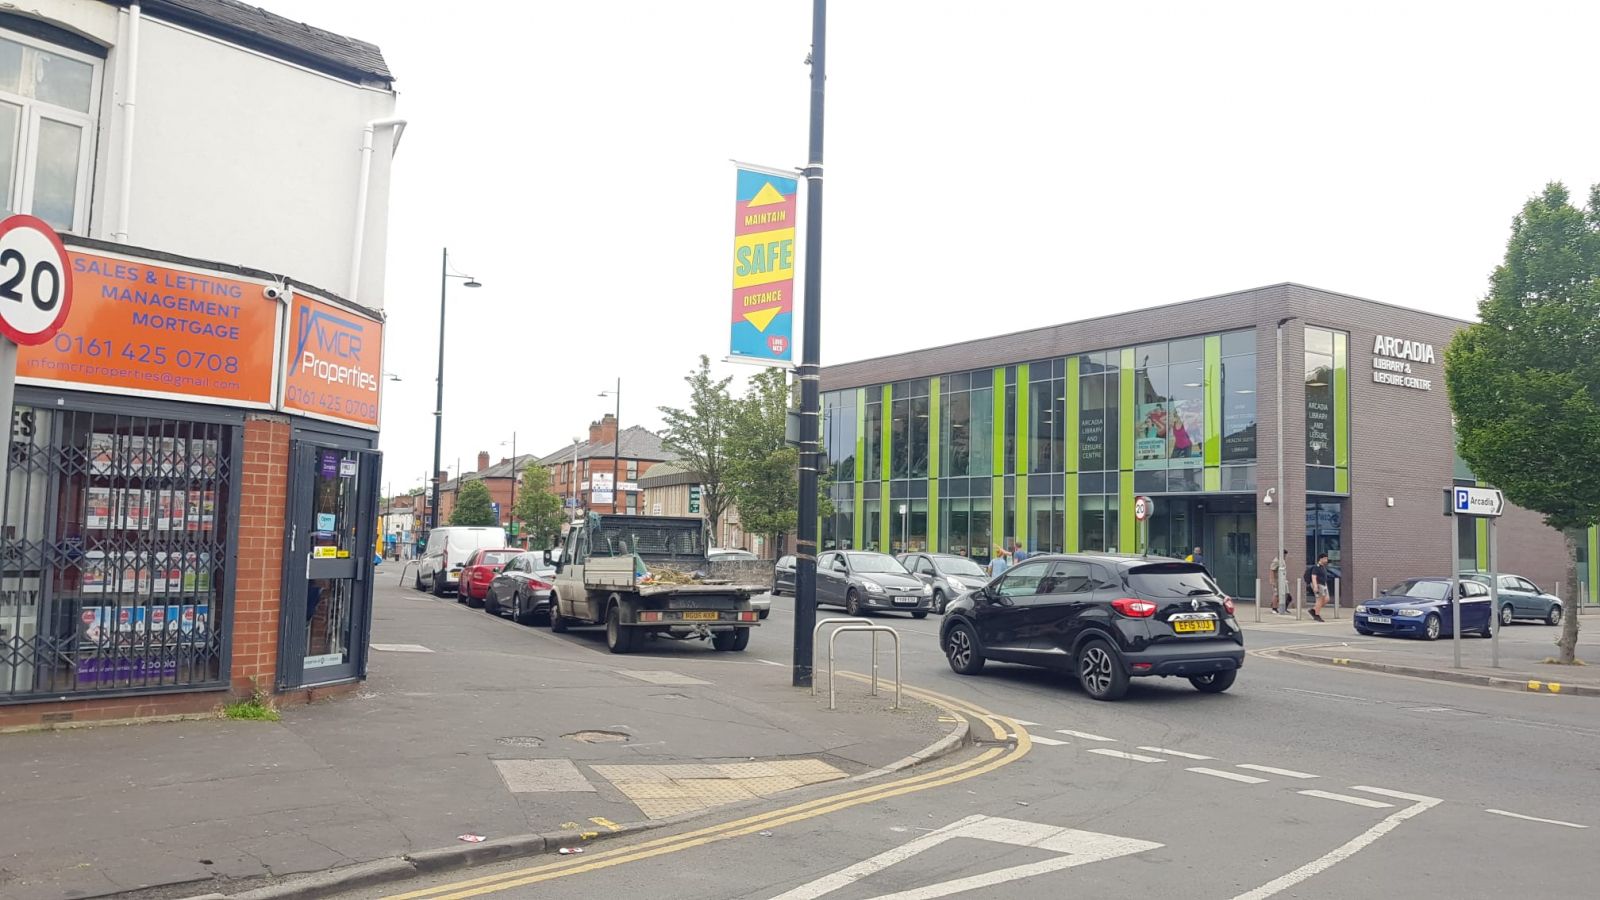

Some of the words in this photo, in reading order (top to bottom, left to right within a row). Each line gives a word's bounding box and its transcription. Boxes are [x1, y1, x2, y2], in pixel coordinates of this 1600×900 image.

[745, 210, 787, 226] MAINTAIN
[736, 239, 793, 277] SAFE
[0, 248, 60, 312] 20
[73, 257, 139, 281] SALES
[145, 270, 158, 285] &
[164, 273, 243, 299] LETTING
[101, 284, 241, 319] MANAGEMENT
[744, 290, 782, 307] DISTANCE
[131, 311, 240, 340] MORTGAGE
[53, 332, 114, 358] 0161
[120, 343, 167, 365] 425
[176, 349, 239, 374] 0708
[1373, 334, 1435, 364] ARCADIA
[302, 350, 377, 392] Properties
[1373, 357, 1404, 373] LIBRARY
[1404, 363, 1412, 374] &
[1373, 371, 1404, 387] LEISURE
[1404, 376, 1433, 391] CENTRE
[287, 385, 316, 405] 0161
[319, 393, 342, 411] 425
[345, 399, 376, 418] 0708
[1081, 418, 1103, 426] ARCADIA
[1081, 426, 1103, 434] LIBRARY
[1081, 443, 1103, 451] LEISURE
[1081, 451, 1102, 459] CENTRE
[1459, 491, 1468, 508] P
[1470, 496, 1494, 506] Arcadia
[1179, 621, 1197, 630] EF15
